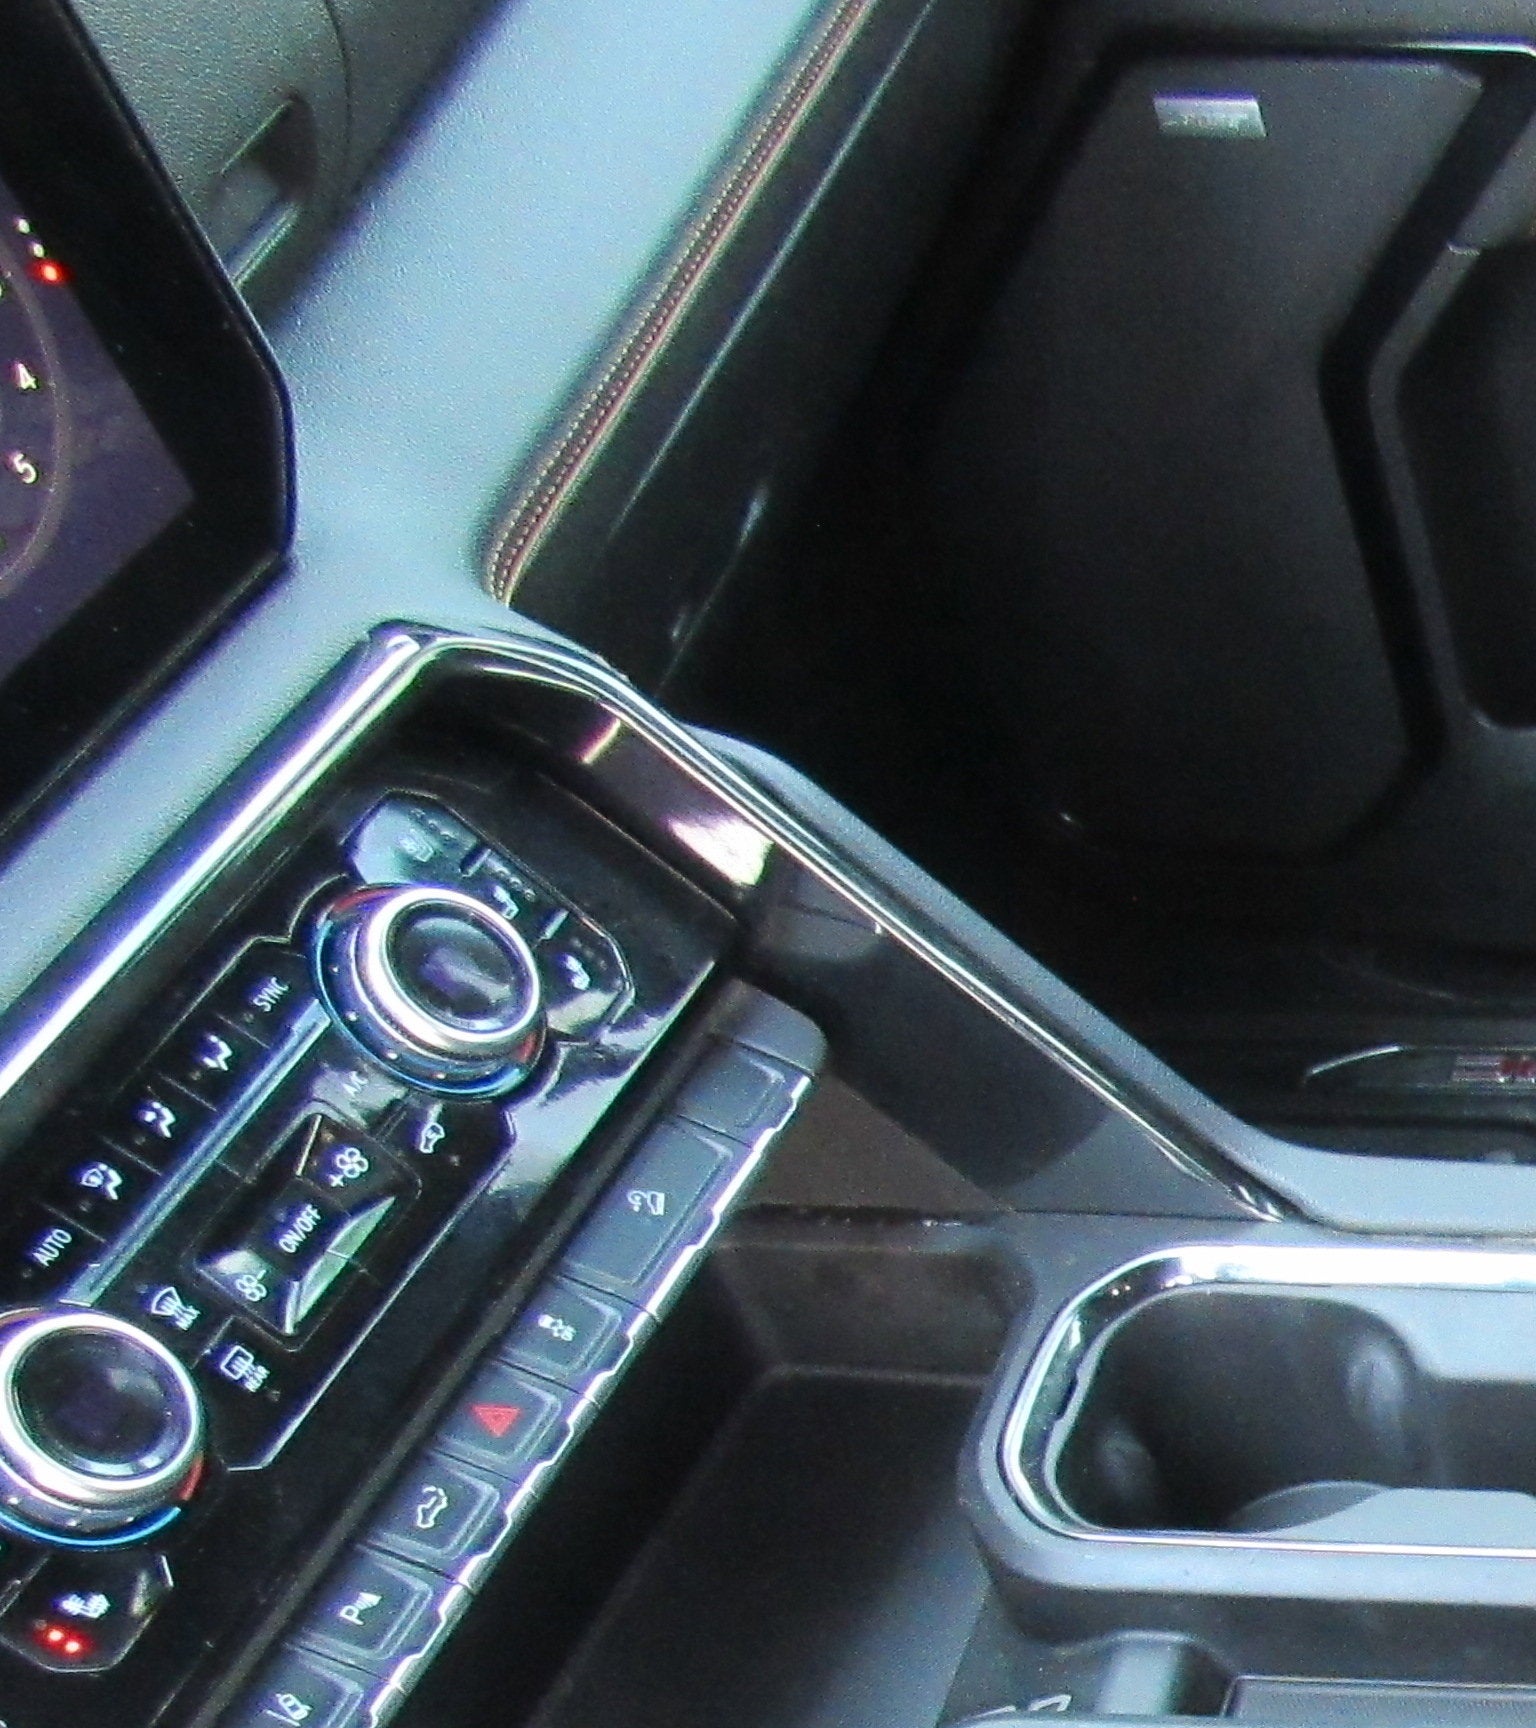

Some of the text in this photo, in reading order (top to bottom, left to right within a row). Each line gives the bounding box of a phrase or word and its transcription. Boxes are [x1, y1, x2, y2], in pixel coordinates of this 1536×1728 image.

[15, 361, 37, 390] 4
[13, 453, 37, 484] 5
[253, 976, 289, 1012] SYNC
[278, 1203, 321, 1254] ON/OFF
[32, 1229, 72, 1267] AUTO
